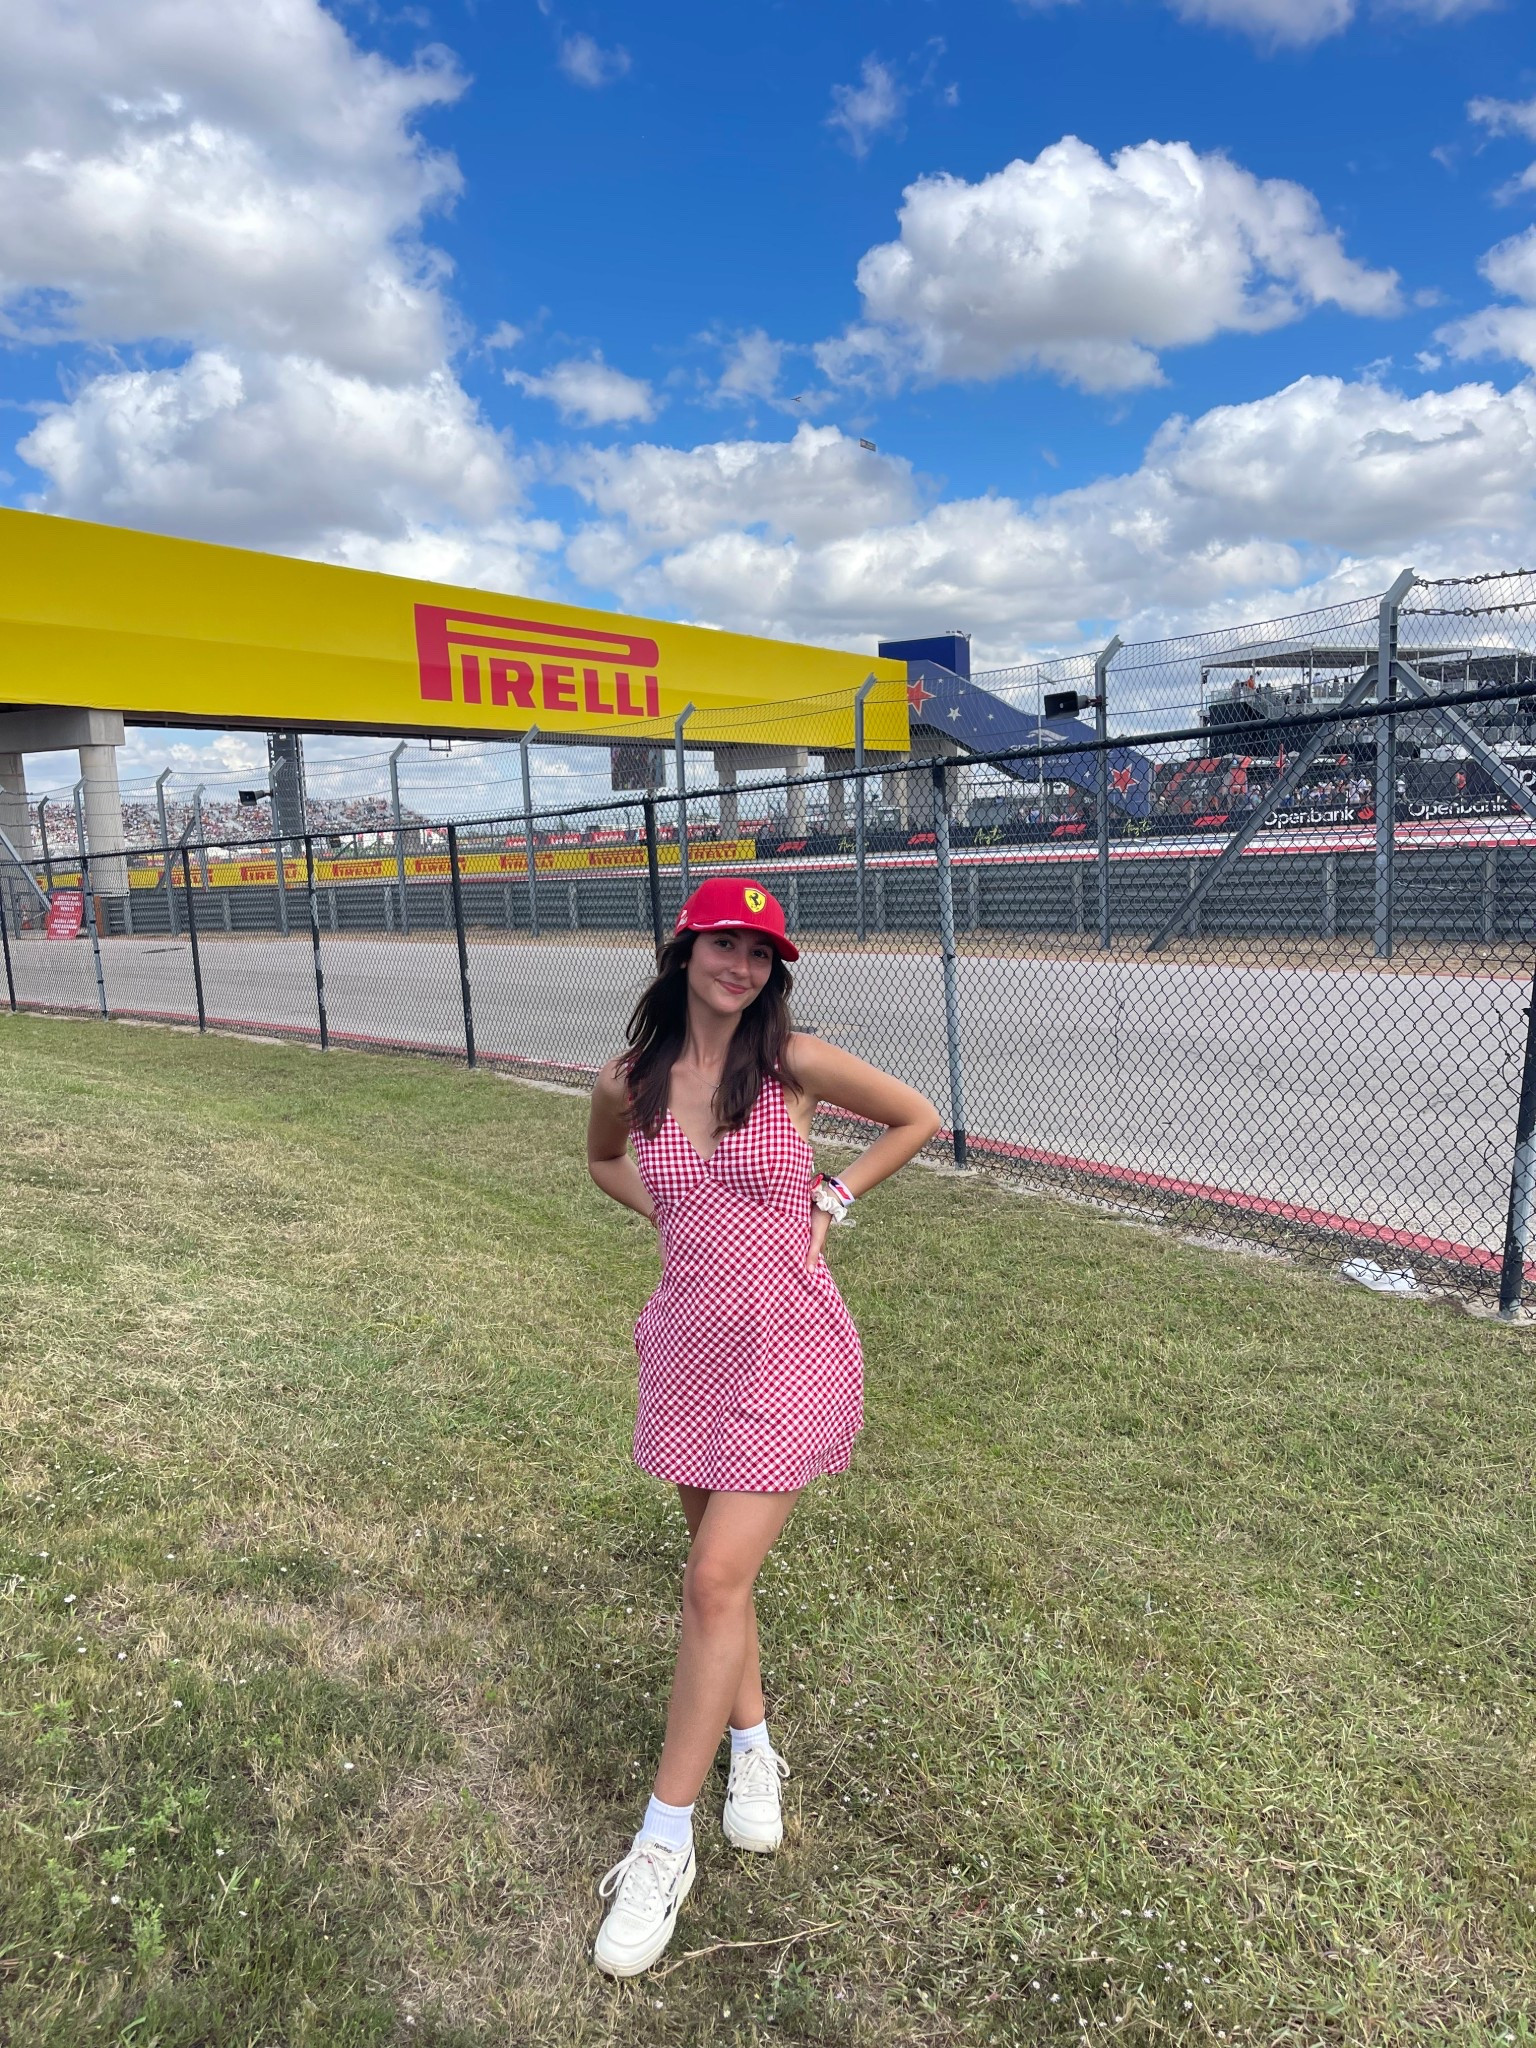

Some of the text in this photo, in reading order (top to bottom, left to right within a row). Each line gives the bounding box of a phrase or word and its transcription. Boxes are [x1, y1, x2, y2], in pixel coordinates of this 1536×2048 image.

[414, 603, 660, 717] PIRELLI
[270, 750, 275, 758] 2
[1264, 805, 1355, 829] Openbank
[589, 849, 645, 866] PIRELLI
